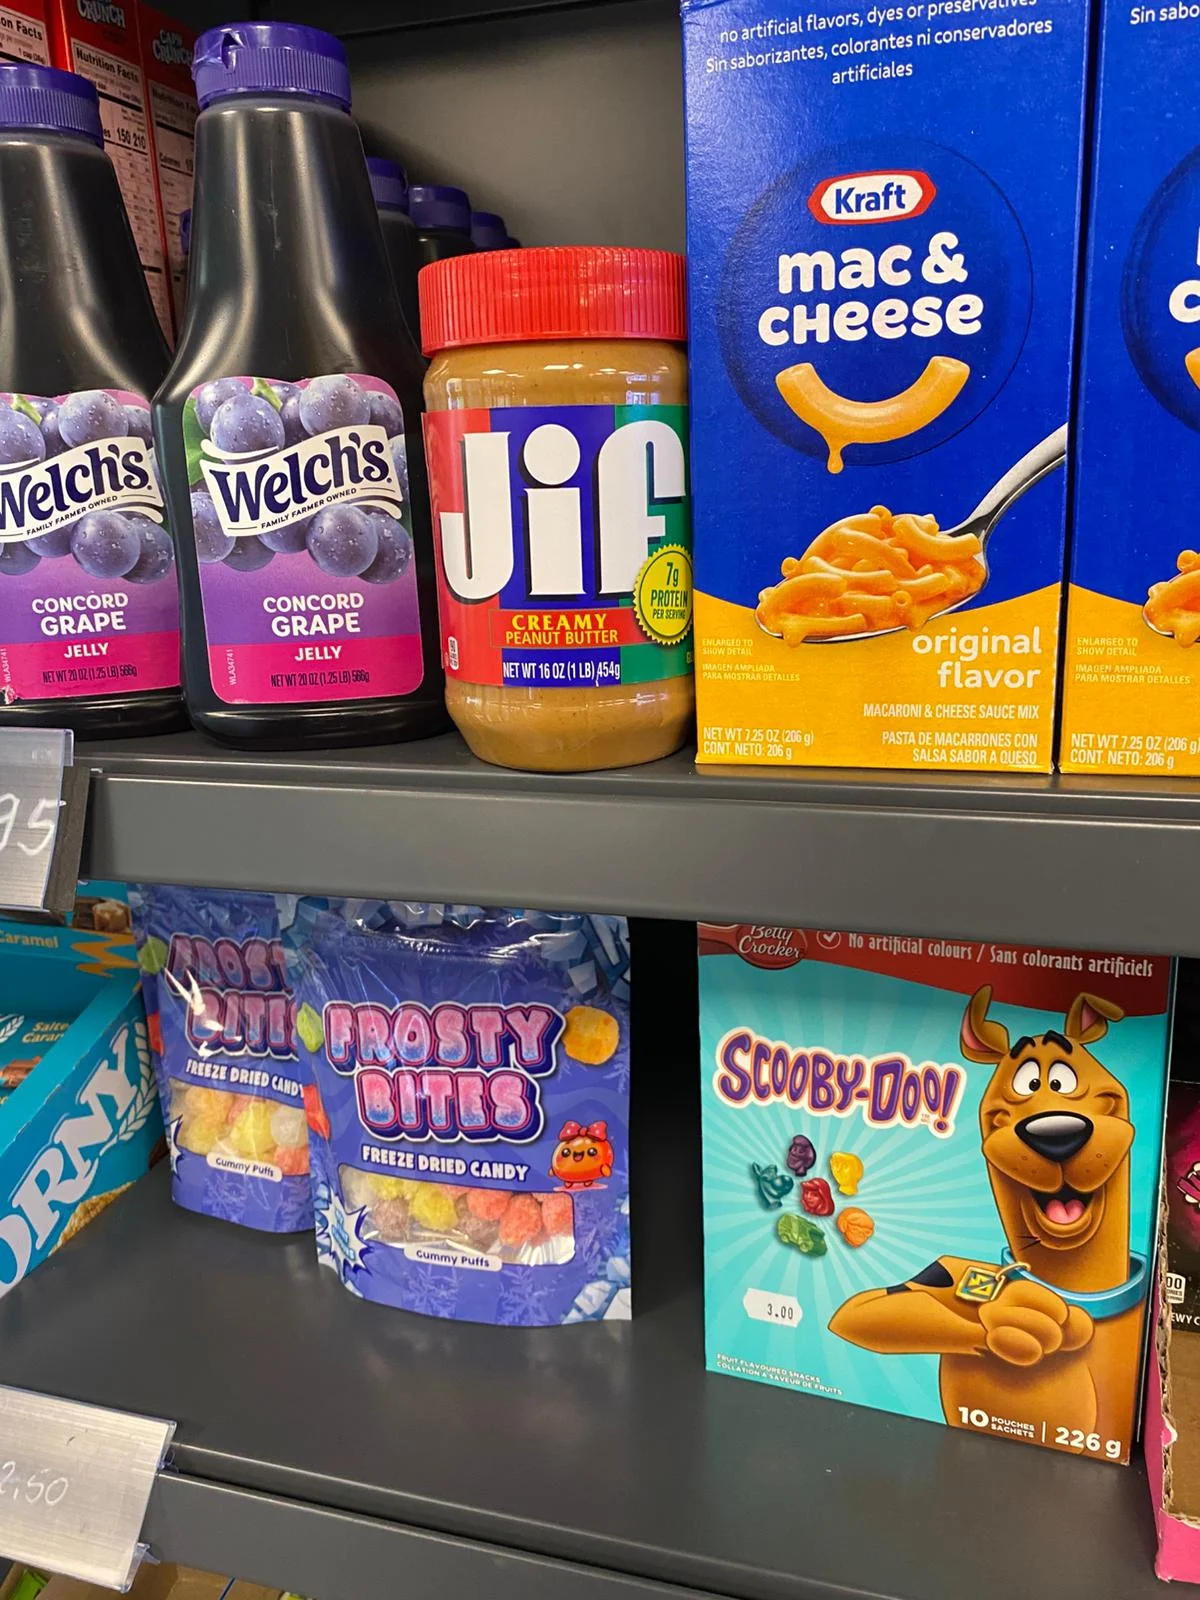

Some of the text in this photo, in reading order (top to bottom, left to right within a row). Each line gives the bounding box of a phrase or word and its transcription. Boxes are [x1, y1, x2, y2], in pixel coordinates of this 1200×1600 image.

[77, 0, 126, 29] CRUNCH
[720, 0, 1037, 44] no artificial flavors, dyes or preservatives
[1130, 5, 1156, 25] Sin
[16, 20, 43, 40] Facts
[706, 19, 1053, 73] Sin saborizantes, colorantes ni conservadores
[76, 47, 116, 73] Nutrition
[117, 64, 139, 82] Facts
[832, 61, 913, 85] artificiales
[834, 182, 906, 214] Kraft
[778, 231, 969, 295] mac &
[209, 432, 390, 522] Welch's
[26, 495, 118, 536] FAMILY FARMER OWNED
[261, 488, 357, 529] FAMILY FARMER OWNED
[440, 420, 686, 600] Jif
[666, 562, 679, 588] 7g
[32, 592, 129, 614] CONCORD
[263, 592, 364, 614] CONCORD
[650, 589, 688, 608] PROTEIN
[40, 611, 127, 636] GRAPE
[271, 612, 361, 637] GRAPE
[511, 613, 607, 631] CREAMY
[652, 609, 686, 620] PER SERVING
[505, 630, 619, 645] PEANUT BUTTER
[702, 638, 743, 648] ENLARGED
[912, 626, 1042, 662] original
[1076, 637, 1126, 647] ENLARGED
[63, 642, 109, 659] JELLY
[294, 645, 343, 661] JELLY
[702, 647, 753, 657] SHOW DETAIL
[1076, 646, 1137, 657] SHOW DETAIL
[42, 664, 137, 683] NET WT 20 OZ (1.25 LB) 566g
[503, 661, 621, 681] NET WT 16 OZ (1 LB) 454g
[702, 663, 776, 673] IMAGEN AMPLIADA
[702, 672, 801, 682] PARA MOSTRAR DETALLES
[937, 661, 1041, 689] flavor
[1075, 664, 1162, 674] IMAGEN AMPLIADA
[271, 669, 370, 688] NET WT 20 OZ (1.25 LB) 566g
[1075, 673, 1191, 685] PARA MOSTRAR DETALLES
[863, 703, 1040, 720] MACARONI & CHEESE SAUCE MIX
[703, 727, 814, 747] NET WT 7.25 OZ (206 g)
[882, 731, 1038, 748] PASTA DE MACARRONES CON
[1071, 733, 1187, 753] NET WT 7.25 OZ (206
[767, 744, 793, 760] 206 g
[913, 748, 1038, 765] SALSA SABOR A QUESO
[1107, 750, 1175, 770] NETO: 206 g
[738, 935, 801, 959] Crocker
[848, 933, 1153, 979] No artificial colours Sans colorants artificiels
[325, 1001, 563, 1074] FROSTY
[185, 1059, 270, 1088] FREEZE DRIED
[356, 1068, 542, 1140] BITES
[0, 1028, 137, 1298] ORNY
[215, 1158, 274, 1178] Gummy Puffs
[362, 1145, 529, 1182] FREEZE DRIED CANDY
[416, 1249, 491, 1269] Gummy Puffs
[767, 1303, 794, 1320] 3.00
[716, 1353, 821, 1383] FRUIT FLAVOURED SNACKS
[716, 1361, 843, 1396] COLLATION SAVEUR DE FRUITS
[958, 1406, 989, 1428] 10
[991, 1416, 1036, 1432] POUCHES
[991, 1423, 1035, 1439] SACHETS
[1055, 1426, 1122, 1459] 226 g
